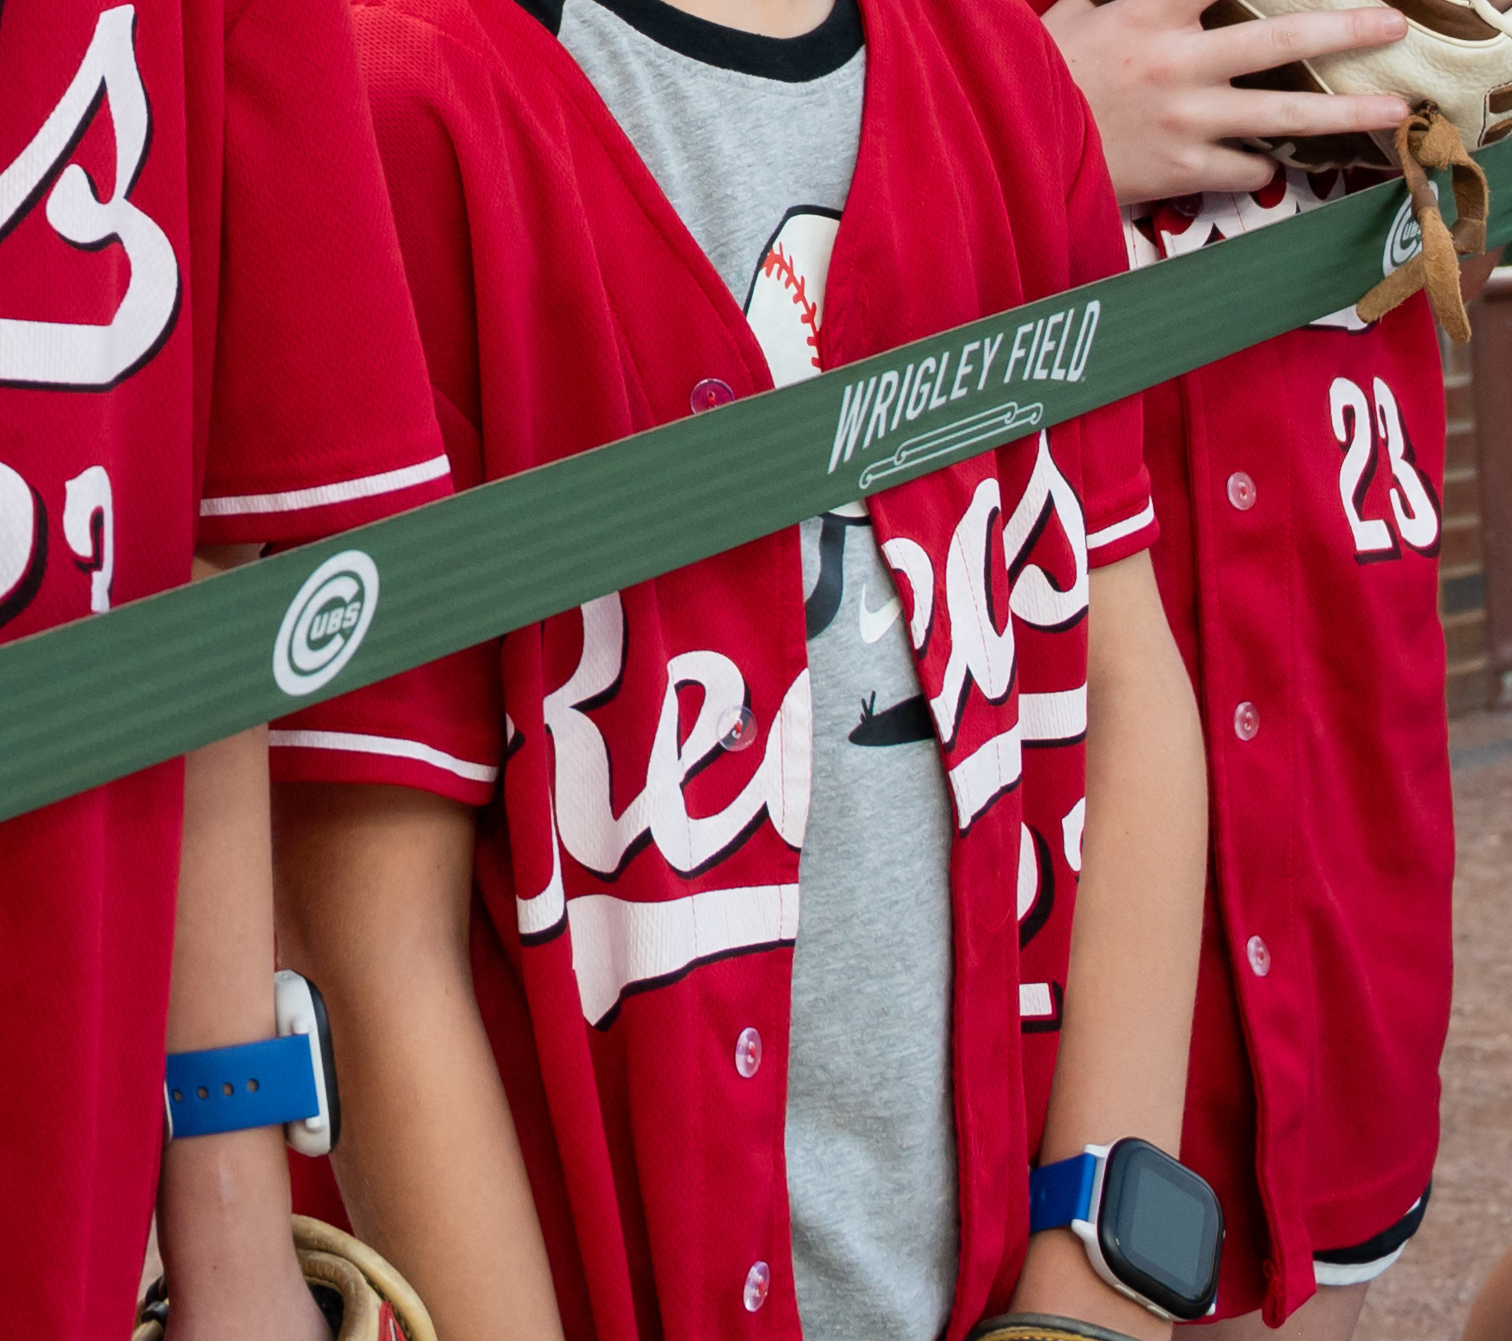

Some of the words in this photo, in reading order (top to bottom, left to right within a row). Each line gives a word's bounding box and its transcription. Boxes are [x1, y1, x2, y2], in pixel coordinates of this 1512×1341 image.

[827, 332, 1004, 475] WRIGLEY
[1003, 299, 1100, 384] FIELD
[1329, 375, 1442, 565] 23
[291, 575, 361, 672] CUBS
